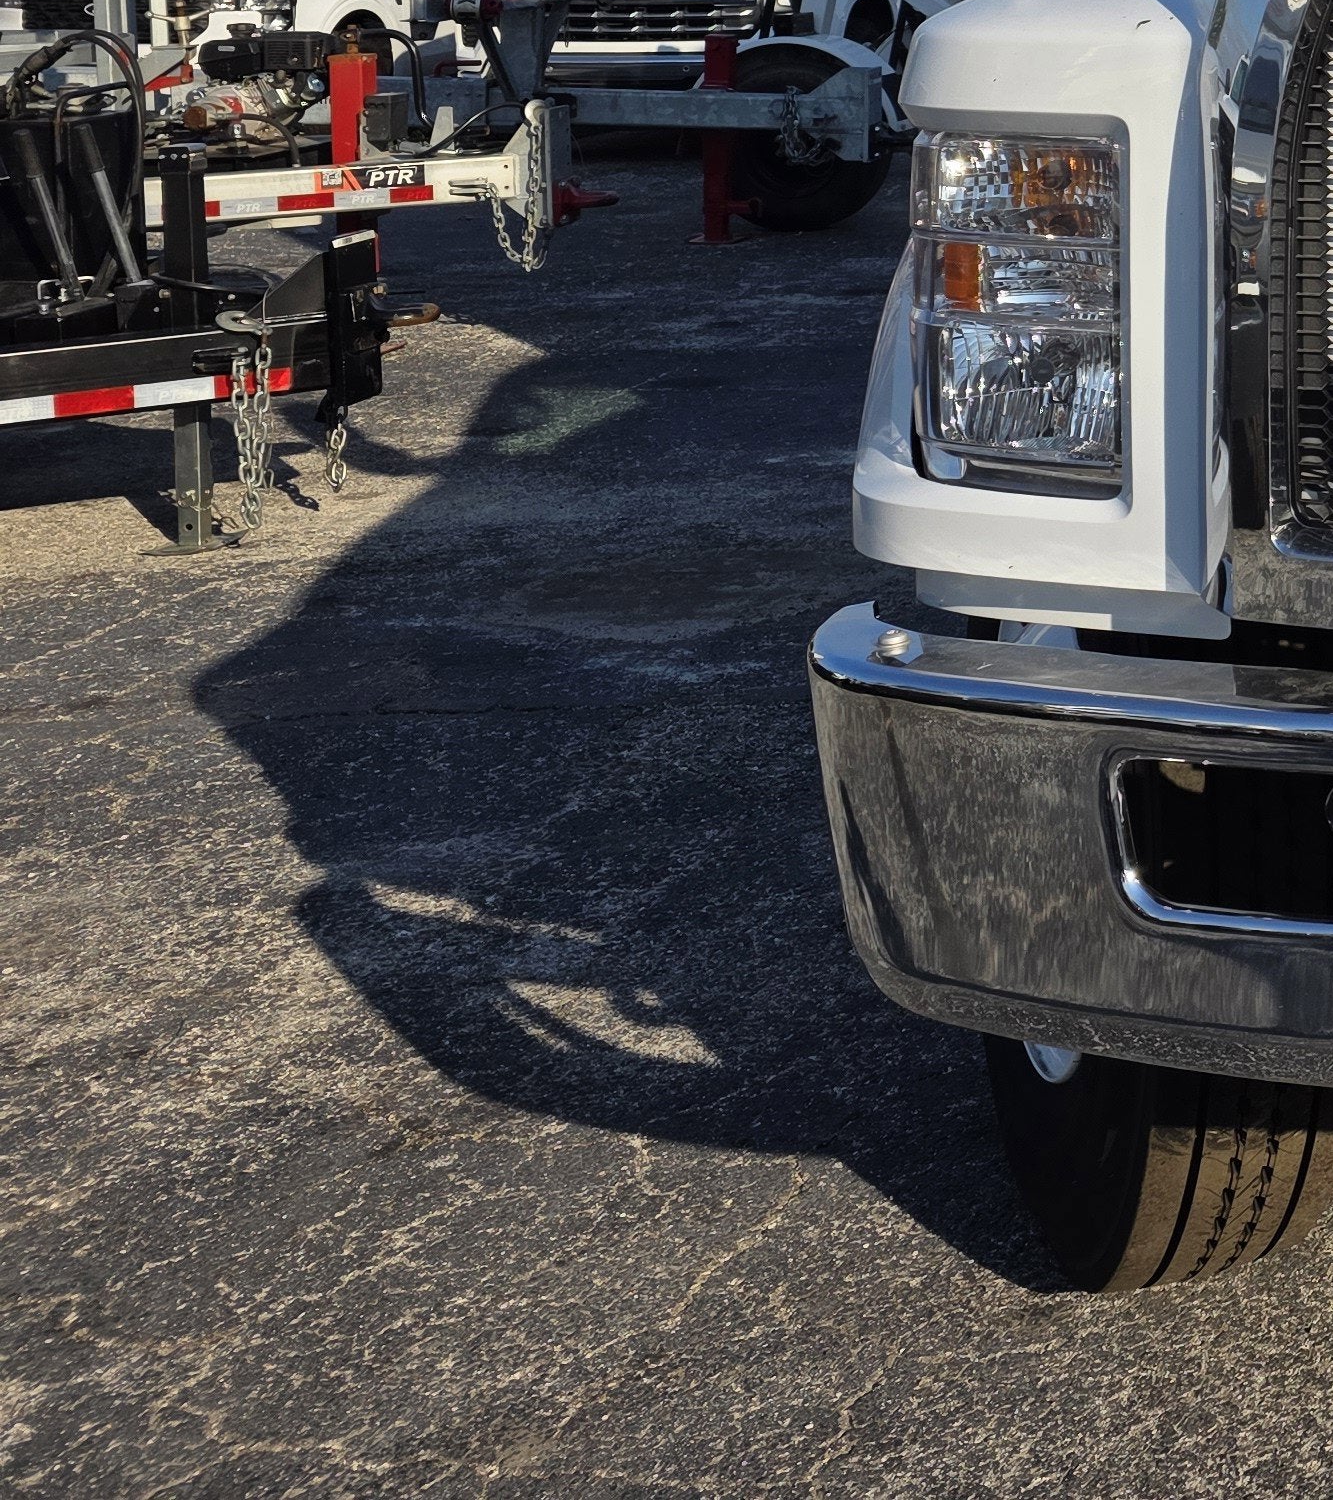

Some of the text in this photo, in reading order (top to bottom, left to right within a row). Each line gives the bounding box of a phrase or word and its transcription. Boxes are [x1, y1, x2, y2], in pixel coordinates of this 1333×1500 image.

[369, 169, 415, 187] PTR
[351, 194, 375, 205] PTR
[235, 203, 262, 214] PTR
